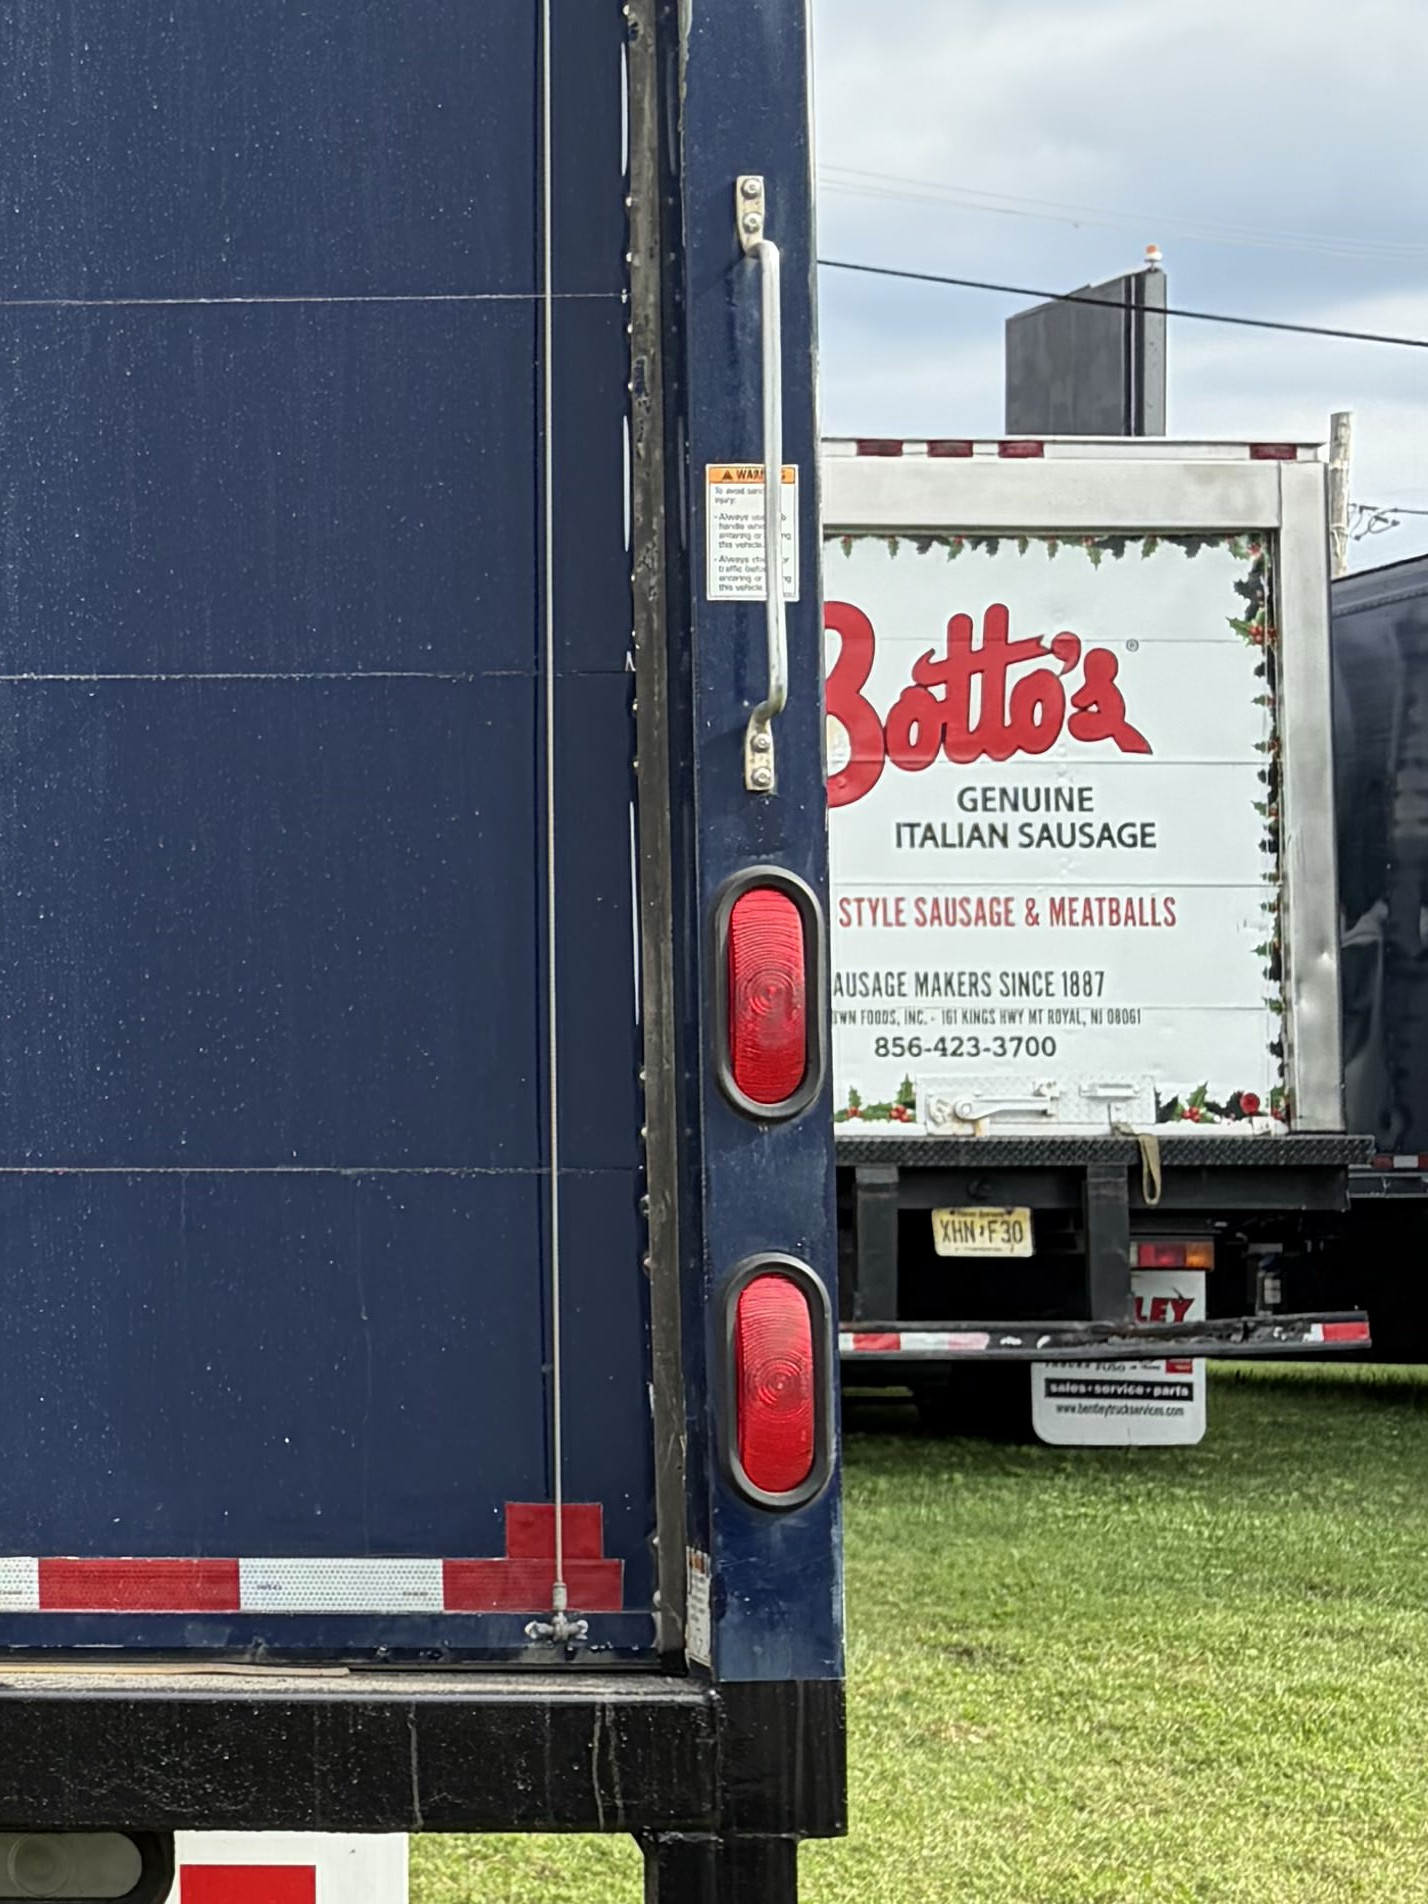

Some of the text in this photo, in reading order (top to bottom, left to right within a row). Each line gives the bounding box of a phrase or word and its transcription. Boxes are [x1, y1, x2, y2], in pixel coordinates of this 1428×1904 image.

[824, 600, 1153, 809] Botto's
[957, 786, 1095, 813] GENUINE
[895, 821, 1158, 849] ITALIAN SAUSAGE
[838, 896, 1178, 928] STYLE SAUSAGE & MEATBALLS
[833, 970, 1105, 998] AUSAGE MAKERS SINCE 1887
[860, 1008, 901, 1027] FOODS,
[904, 1008, 928, 1026] INC.
[962, 1008, 996, 1026] KINGS
[999, 1008, 1024, 1025] HWY
[1028, 1008, 1044, 1025] MT
[1048, 1008, 1087, 1027] ROYAL,
[874, 1036, 1057, 1058] 856-423-3700
[1050, 1382, 1189, 1398] sales service parts
